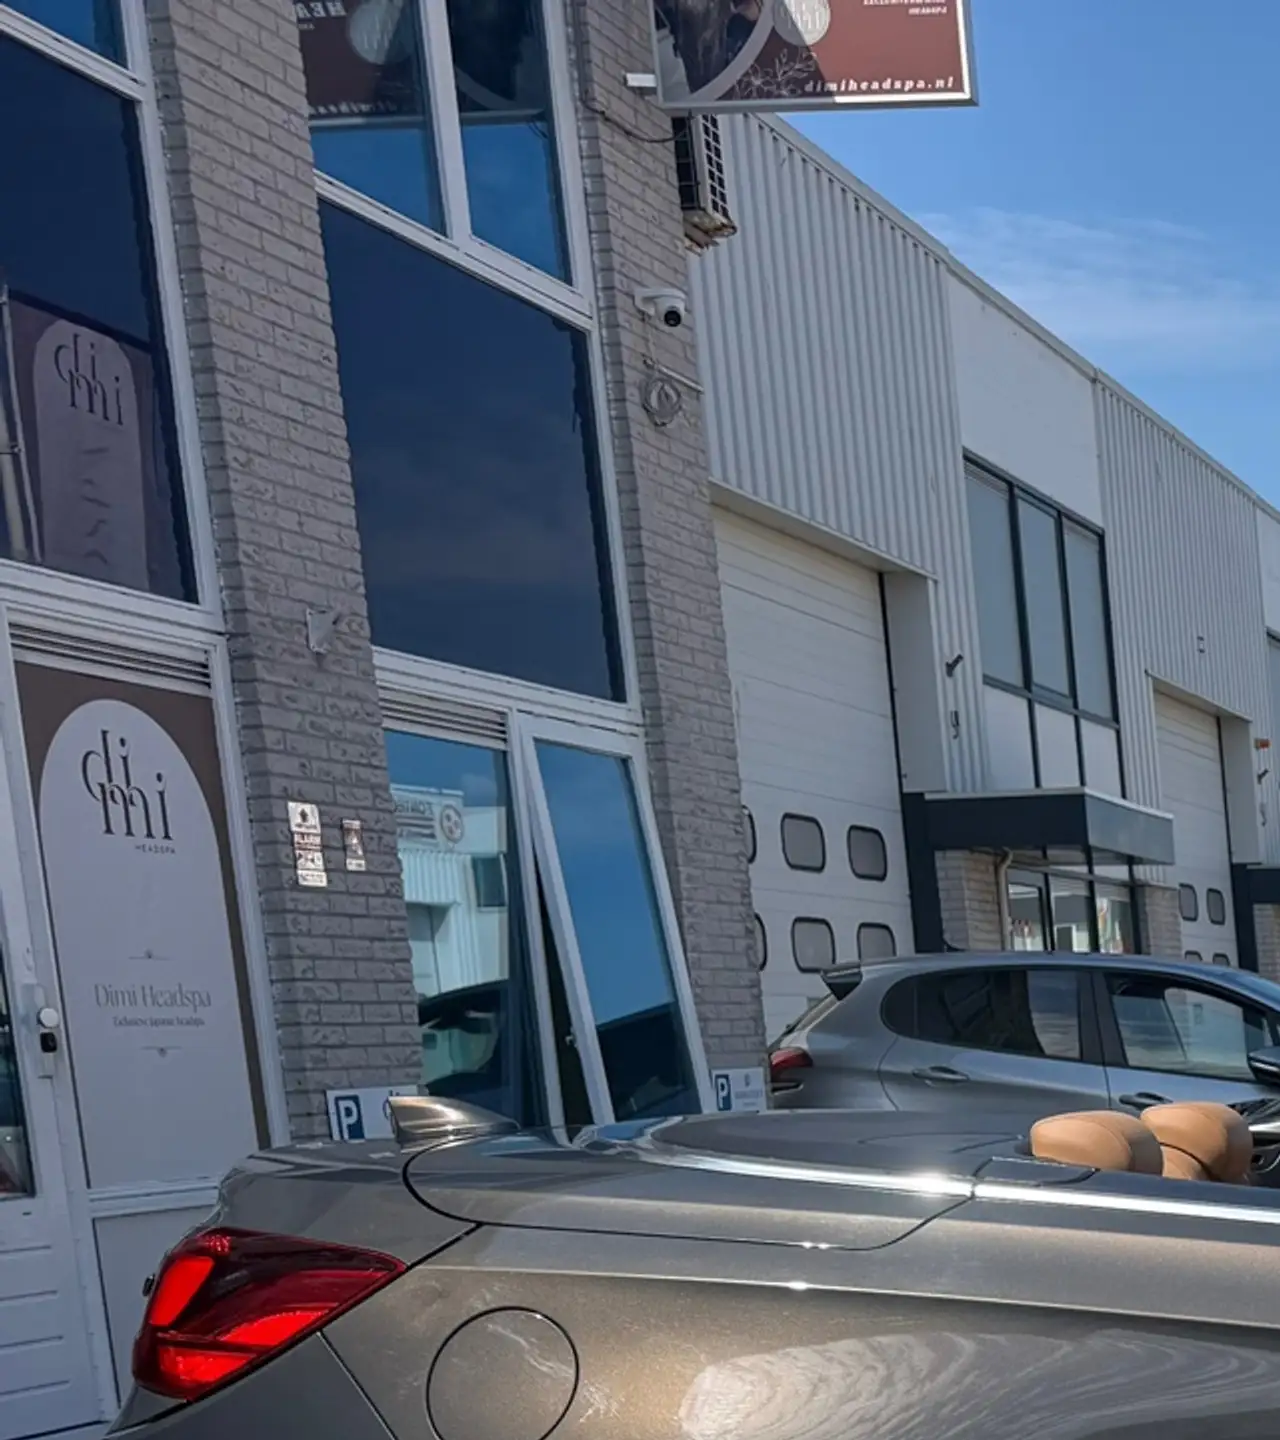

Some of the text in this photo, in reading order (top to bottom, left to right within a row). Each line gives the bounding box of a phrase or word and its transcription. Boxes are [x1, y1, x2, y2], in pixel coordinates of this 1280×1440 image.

[804, 76, 954, 92] dimiheadspa.nl
[93, 982, 212, 1014] Dimi Headspa
[718, 1078, 729, 1109] P
[338, 1099, 359, 1141] P
